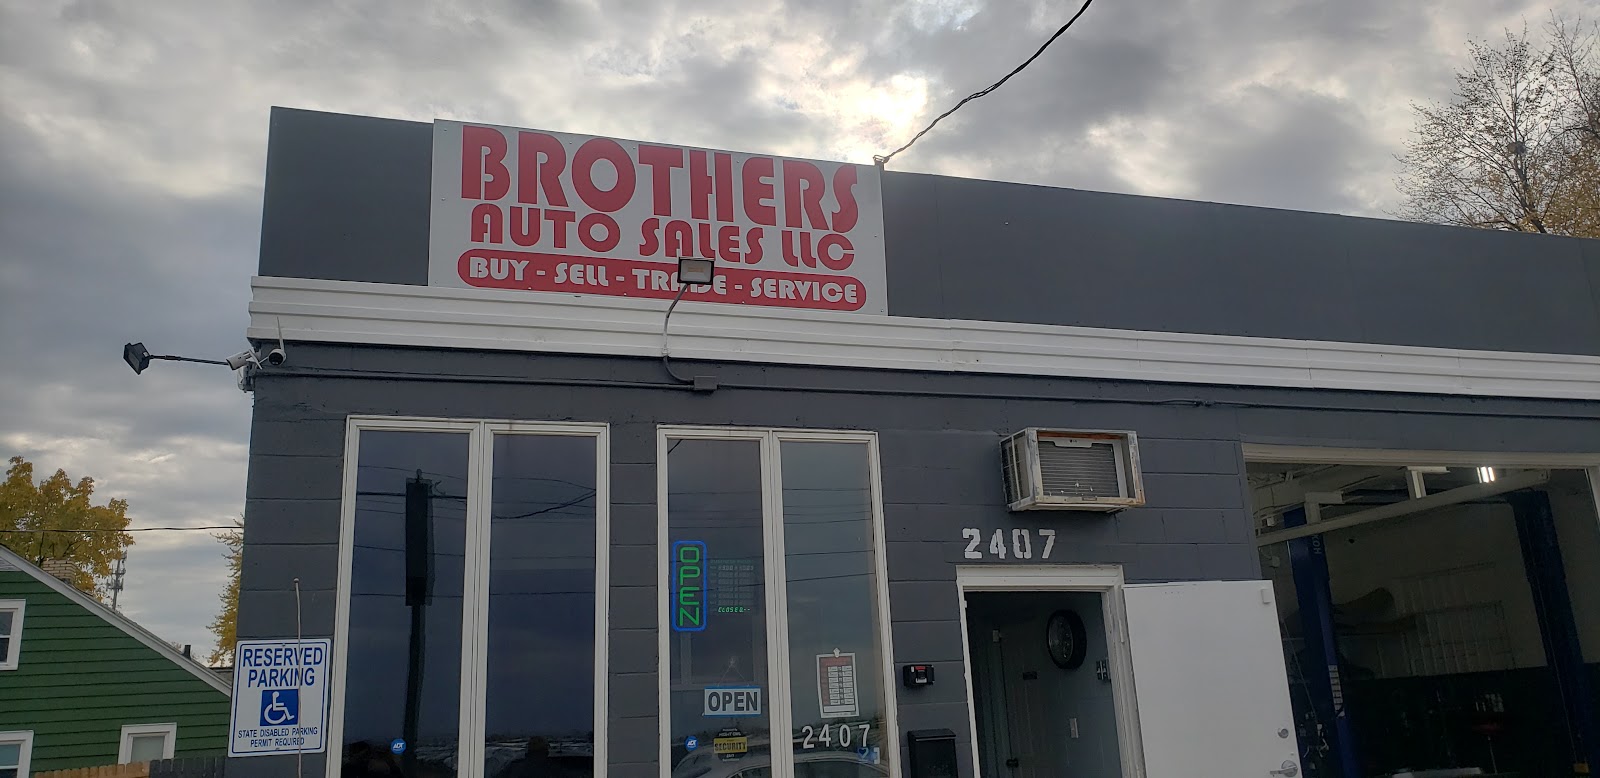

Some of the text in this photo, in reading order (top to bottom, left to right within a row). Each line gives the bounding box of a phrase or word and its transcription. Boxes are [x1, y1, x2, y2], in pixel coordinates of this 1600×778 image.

[461, 125, 859, 234] BROTHERS
[470, 203, 855, 270] AUTO SALES LLC
[469, 256, 530, 281] BUY
[554, 262, 609, 287] SELL
[750, 277, 858, 304] SERVICE
[962, 528, 1056, 559] 2407
[679, 546, 700, 626] OPEN
[242, 647, 323, 667] RESERVED
[247, 667, 315, 688] PARKING
[707, 691, 758, 712] OPEN
[238, 727, 318, 738] STATE DISABLED PARKING
[250, 737, 305, 747] PERMIT REQUIRED
[801, 723, 871, 749] 2407
[714, 742, 746, 751] SECURITY
